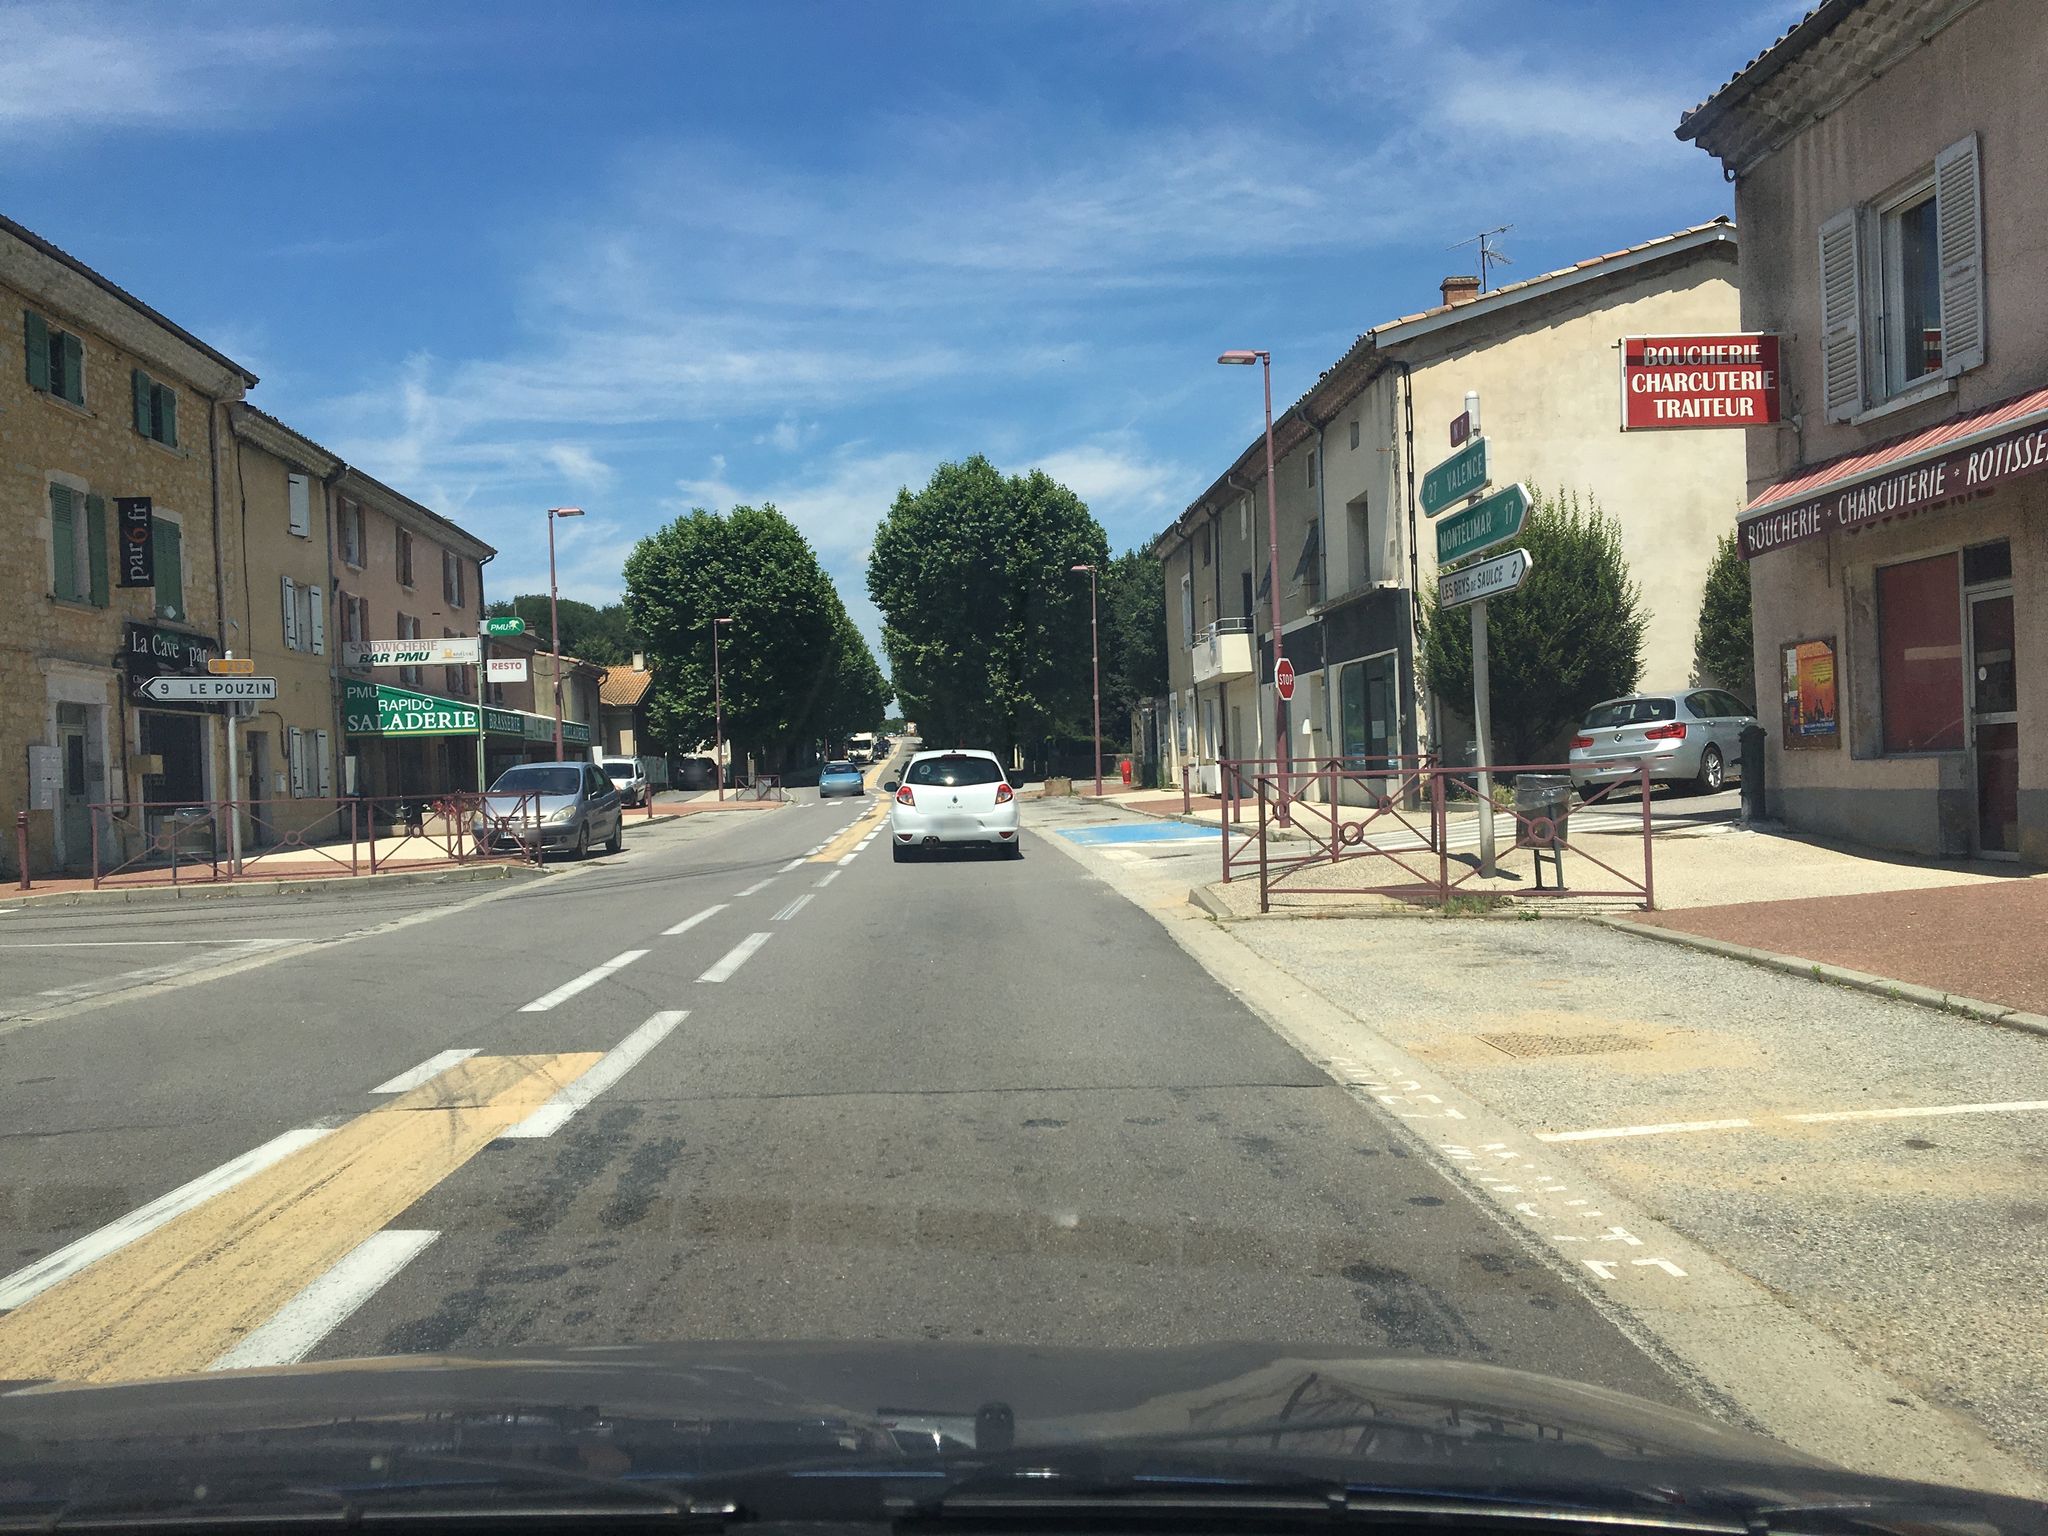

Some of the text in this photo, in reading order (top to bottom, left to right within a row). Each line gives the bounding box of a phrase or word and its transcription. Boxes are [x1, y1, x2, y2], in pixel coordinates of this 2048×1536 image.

[1644, 345, 1763, 366] BOUCHERIE
[1632, 371, 1775, 393] CHARCUTERIE
[1653, 397, 1754, 418] TRAITEUR
[1460, 420, 1465, 436] 7
[1428, 453, 1483, 504] 27 VALENCE
[1748, 503, 1821, 551] BOUCHERIE
[1838, 462, 1947, 525] CHARCUTERIE
[1966, 428, 2048, 486] ROTISSE
[1439, 500, 1514, 553] MONTÉLIMAR 17
[124, 503, 149, 581] par6.fr
[1441, 582, 1453, 600] LES
[1454, 577, 1469, 597] REYS
[1477, 565, 1503, 588] SAULCE
[1511, 560, 1517, 578] 2
[491, 623, 508, 631] PMU
[132, 631, 148, 653] La
[152, 634, 179, 658] Cave
[351, 640, 438, 652] SANDWICHERIE
[359, 652, 430, 664] BAR PMU
[491, 662, 522, 670] RESTO
[160, 683, 169, 694] 9
[190, 683, 207, 694] LE
[215, 683, 271, 694] POUZIN
[1279, 673, 1293, 685] STOP
[347, 686, 379, 699] PMU
[378, 698, 434, 711] RAPIDO
[347, 711, 476, 732] SALADERIE
[488, 712, 520, 732] BRASSERIE
